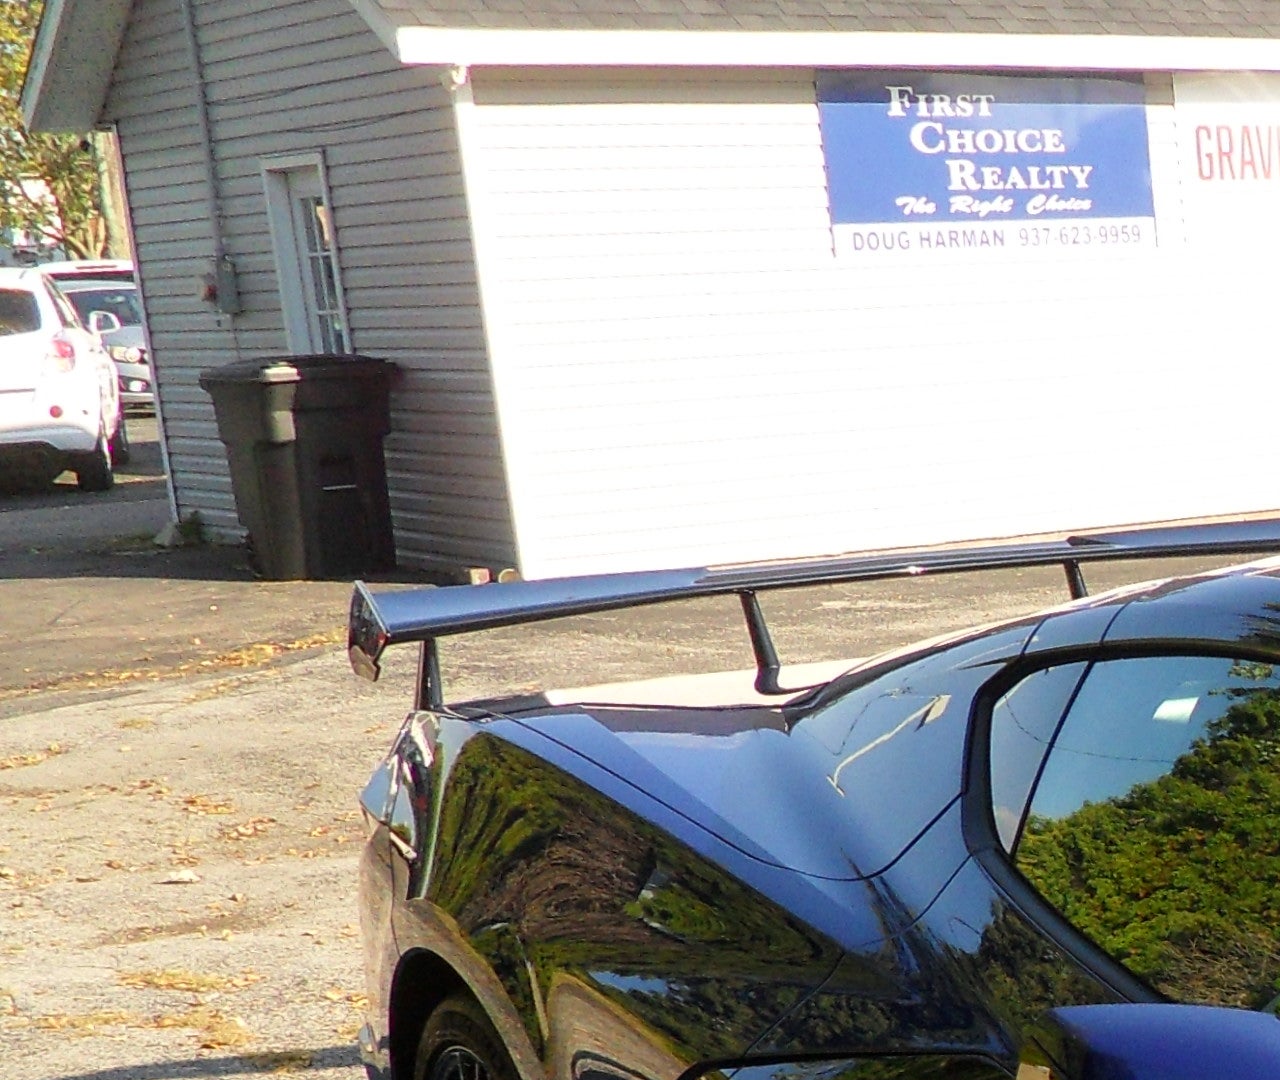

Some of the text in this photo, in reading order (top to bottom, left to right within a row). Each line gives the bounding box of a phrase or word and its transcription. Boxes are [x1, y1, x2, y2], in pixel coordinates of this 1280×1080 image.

[885, 86, 995, 117] FIRST
[910, 121, 1066, 154] CHOICE
[945, 159, 1093, 191] REALTY
[895, 193, 1092, 218] The Right Choice
[853, 230, 911, 251] DOUG
[919, 228, 1005, 250] HARMAN
